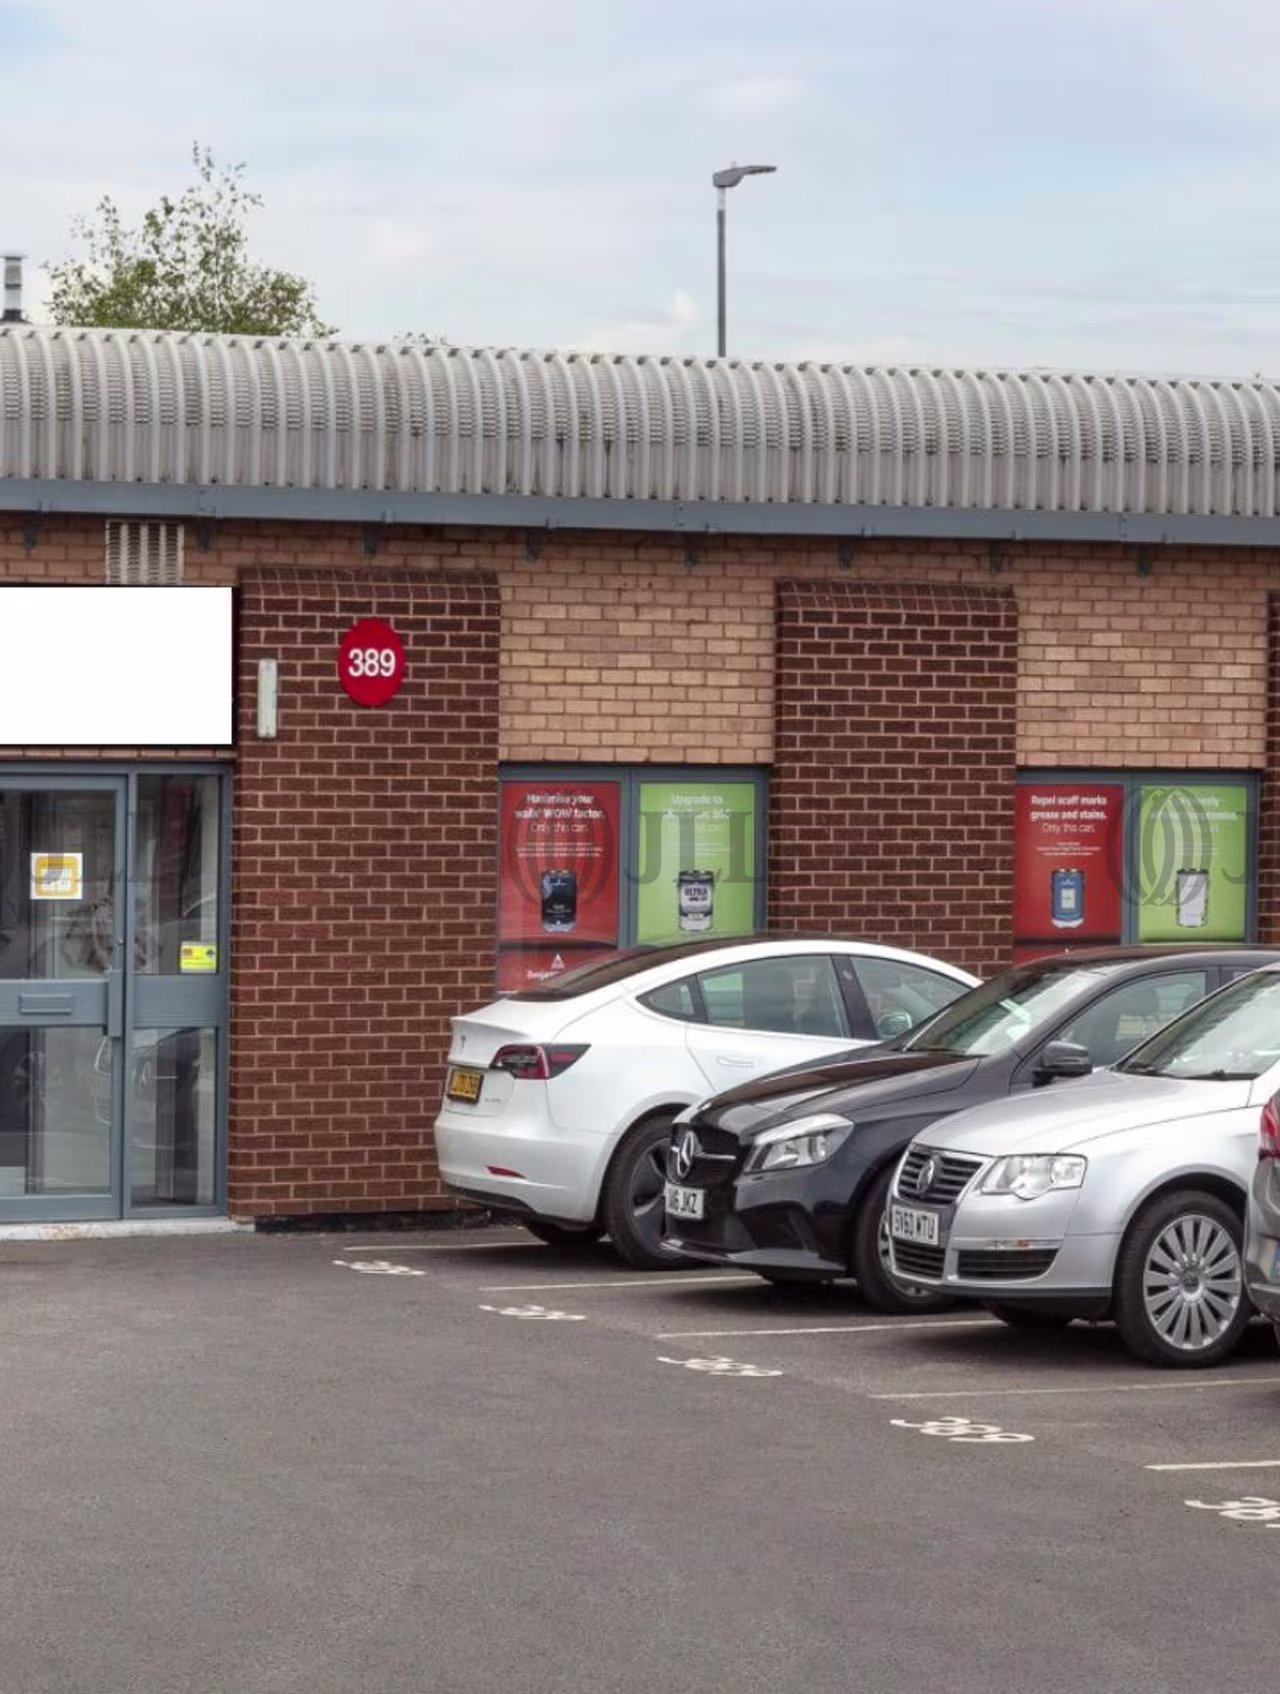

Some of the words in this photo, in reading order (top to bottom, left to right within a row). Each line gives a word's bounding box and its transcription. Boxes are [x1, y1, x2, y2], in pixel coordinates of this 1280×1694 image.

[348, 647, 396, 677] 389
[1031, 794, 1056, 806] Repel
[1080, 794, 1107, 806] marks
[543, 808, 573, 819] WOW
[1030, 810, 1060, 822] grease
[1061, 810, 1079, 820] and
[889, 1416, 1036, 1443] 389
